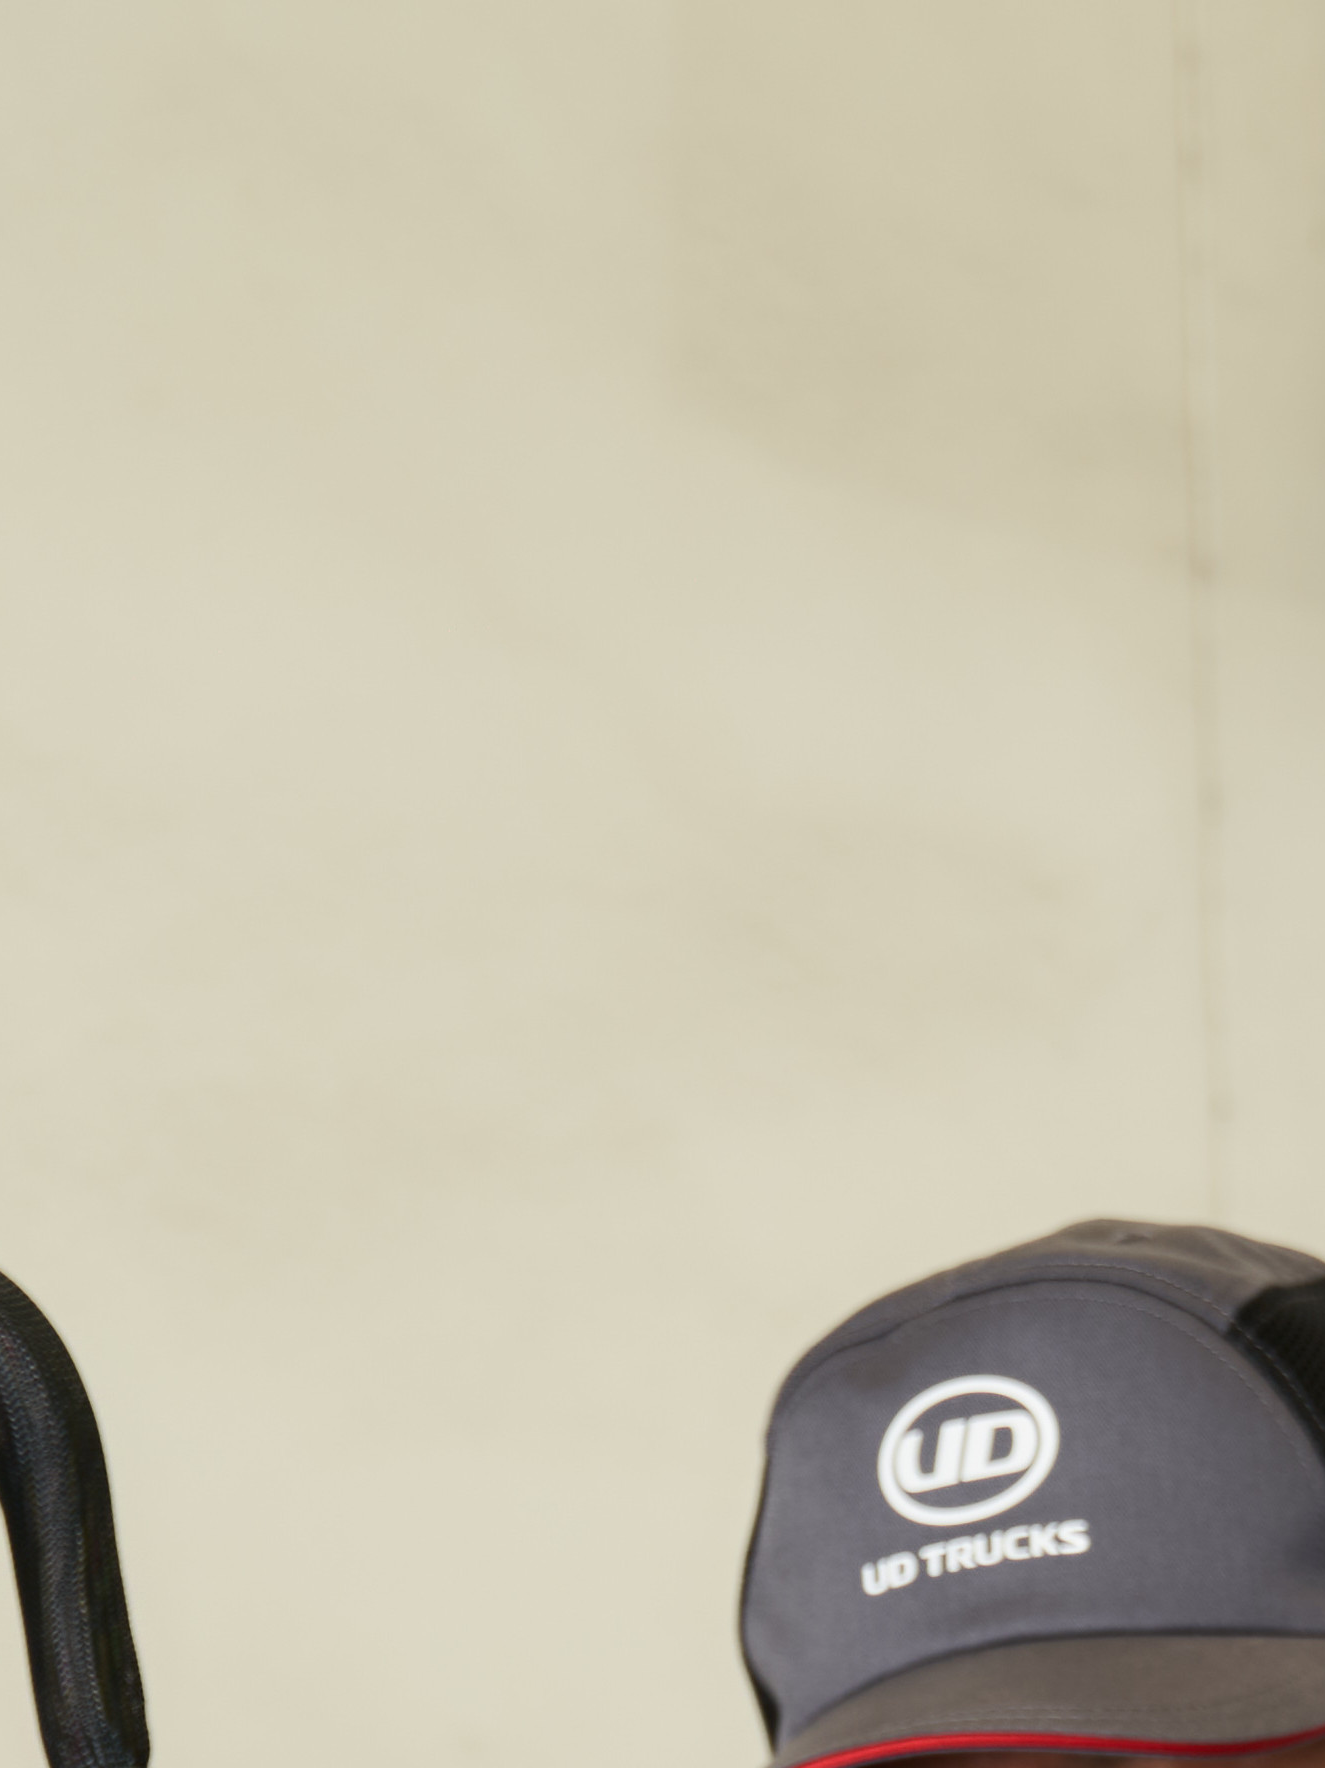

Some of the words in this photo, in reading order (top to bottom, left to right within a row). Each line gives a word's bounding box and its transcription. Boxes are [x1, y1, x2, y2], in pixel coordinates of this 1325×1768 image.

[894, 1408, 1038, 1494] UD
[861, 1552, 918, 1596] UD
[920, 1520, 1091, 1577] TRUCKS
